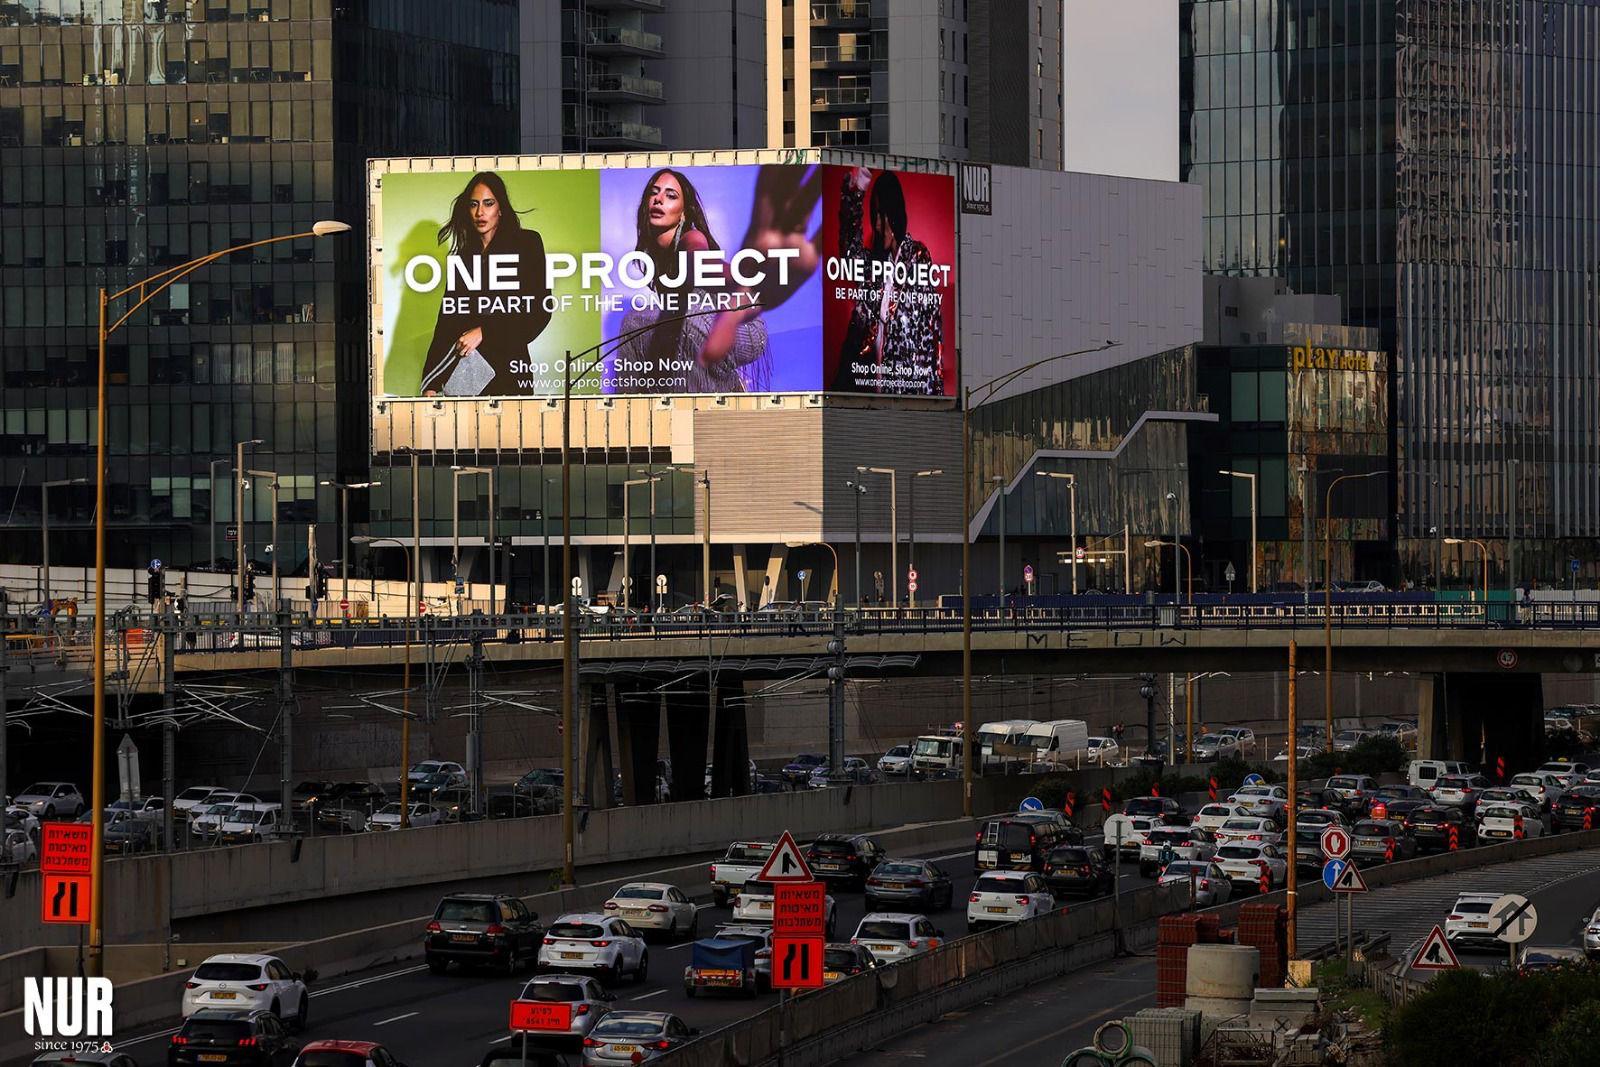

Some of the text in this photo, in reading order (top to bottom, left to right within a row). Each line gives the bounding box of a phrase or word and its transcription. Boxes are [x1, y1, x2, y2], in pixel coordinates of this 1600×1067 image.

[963, 165, 990, 202] NUR
[404, 247, 800, 293] ONE PROJECT
[826, 256, 951, 287] ONE PROJECT
[442, 292, 761, 315] BE PART OF THE ONE PARTY
[835, 287, 943, 305] BE PART OF THE ONE PARTY
[509, 358, 694, 375] Shop Online, Shop Now
[851, 361, 869, 375] Shop
[895, 363, 913, 377] Shop
[913, 365, 929, 376] Now
[1026, 632, 1187, 649] MEOW
